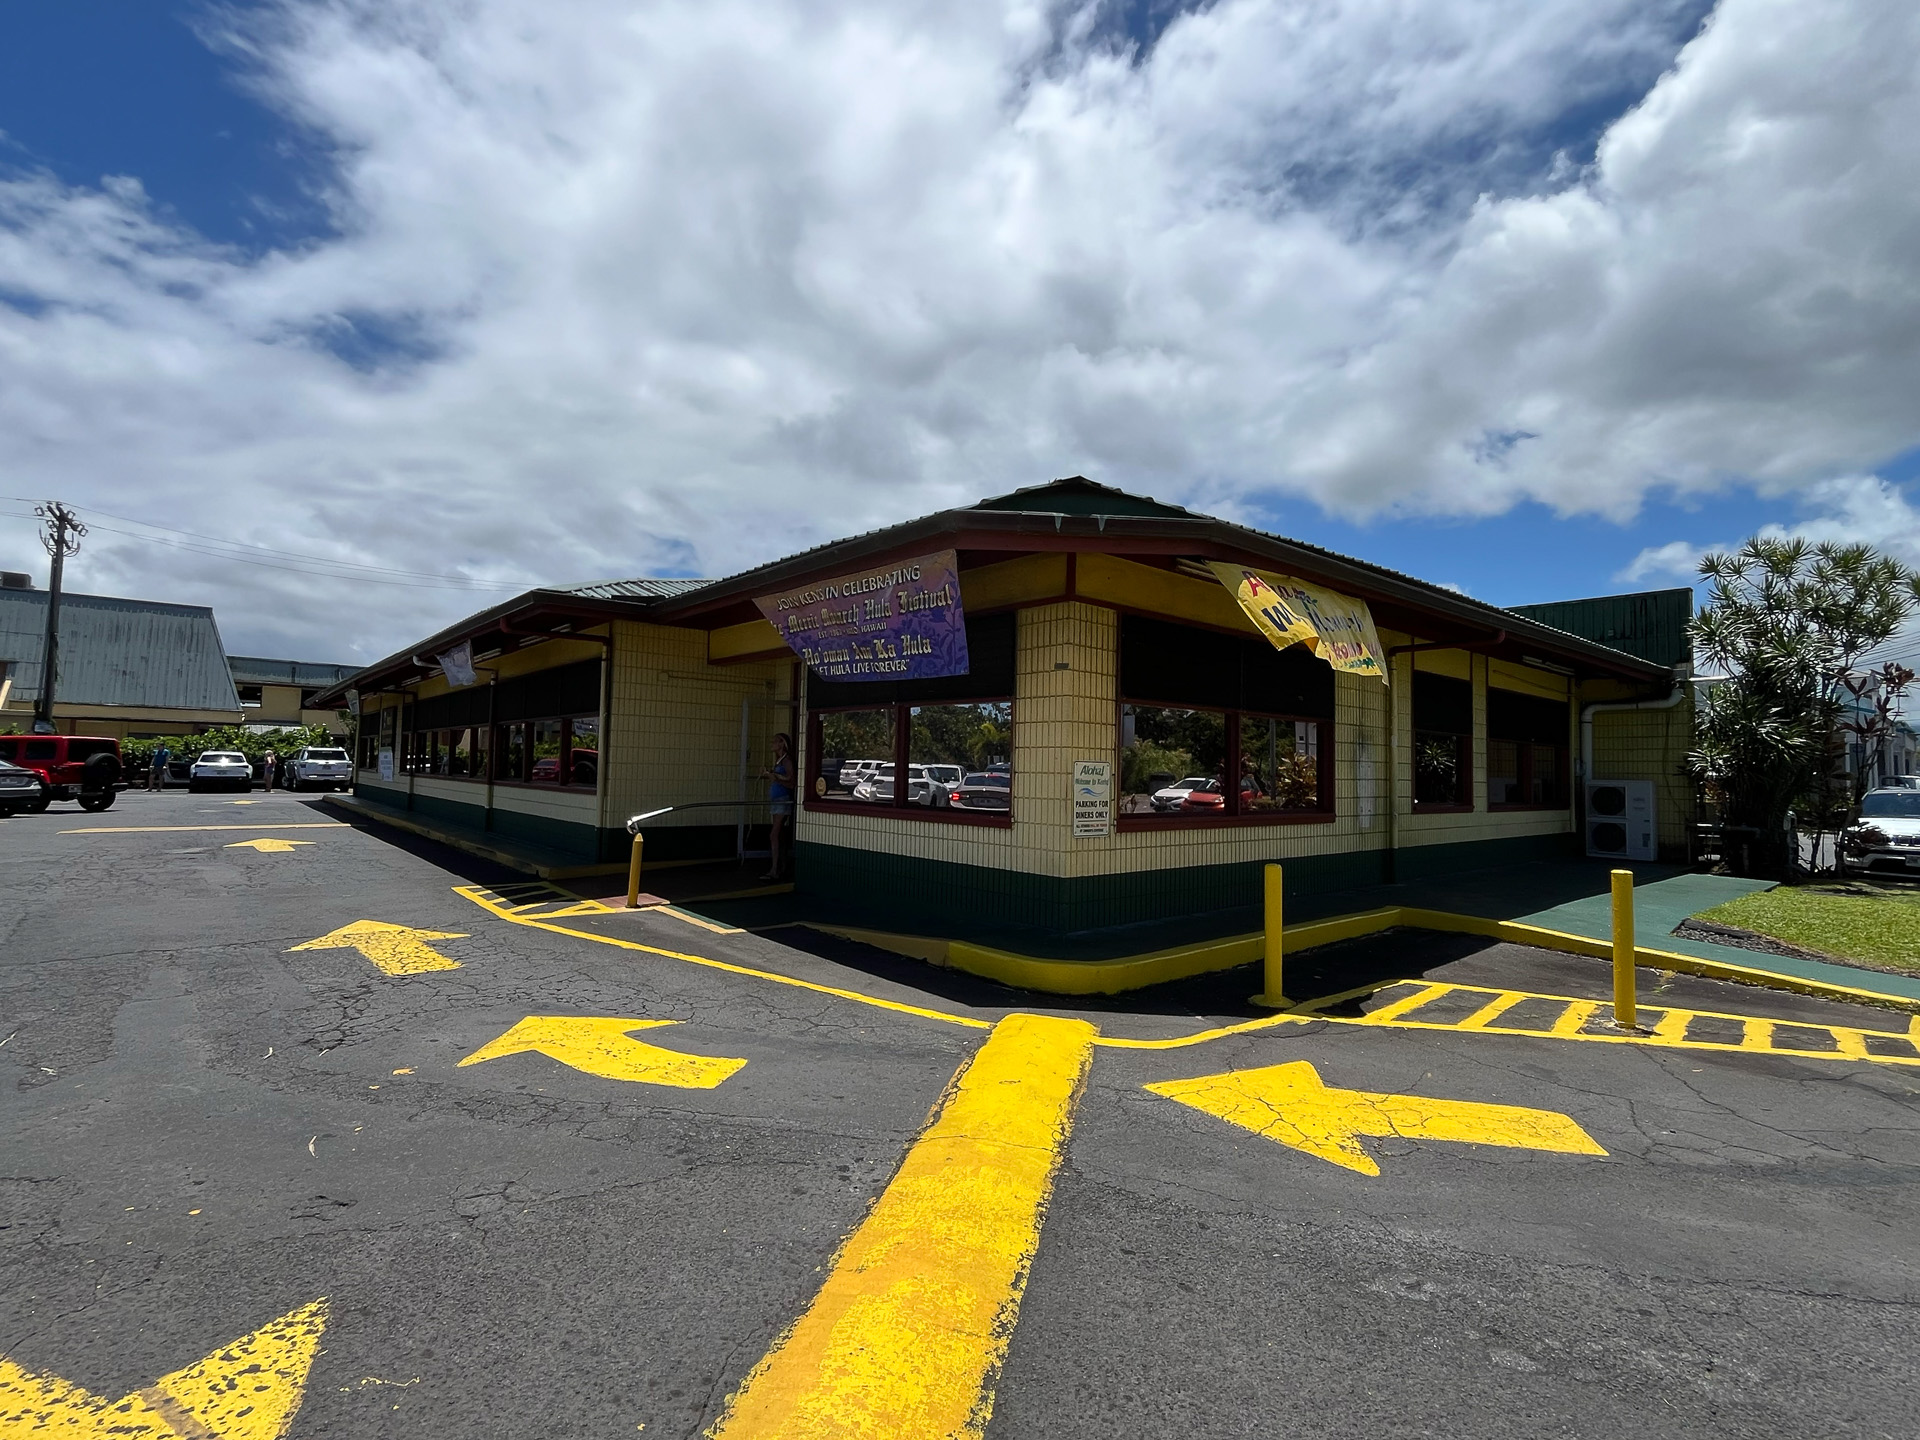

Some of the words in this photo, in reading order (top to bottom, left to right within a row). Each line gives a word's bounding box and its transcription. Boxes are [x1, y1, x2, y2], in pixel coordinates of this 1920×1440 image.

[777, 597, 799, 611] JOIN
[825, 585, 839, 599] IN
[842, 564, 921, 597] CELEBRATING
[788, 613, 820, 634] Merrie
[821, 603, 859, 627] Monarch
[864, 598, 893, 620] Hula
[897, 583, 953, 614] Festival
[900, 634, 933, 656] Hula
[830, 663, 851, 676] HULA
[853, 661, 870, 674] LIVE
[1075, 800, 1098, 809] PARKING
[1098, 800, 1109, 808] FOR
[1075, 811, 1095, 819] DINERS
[1095, 811, 1108, 819] ONLY
